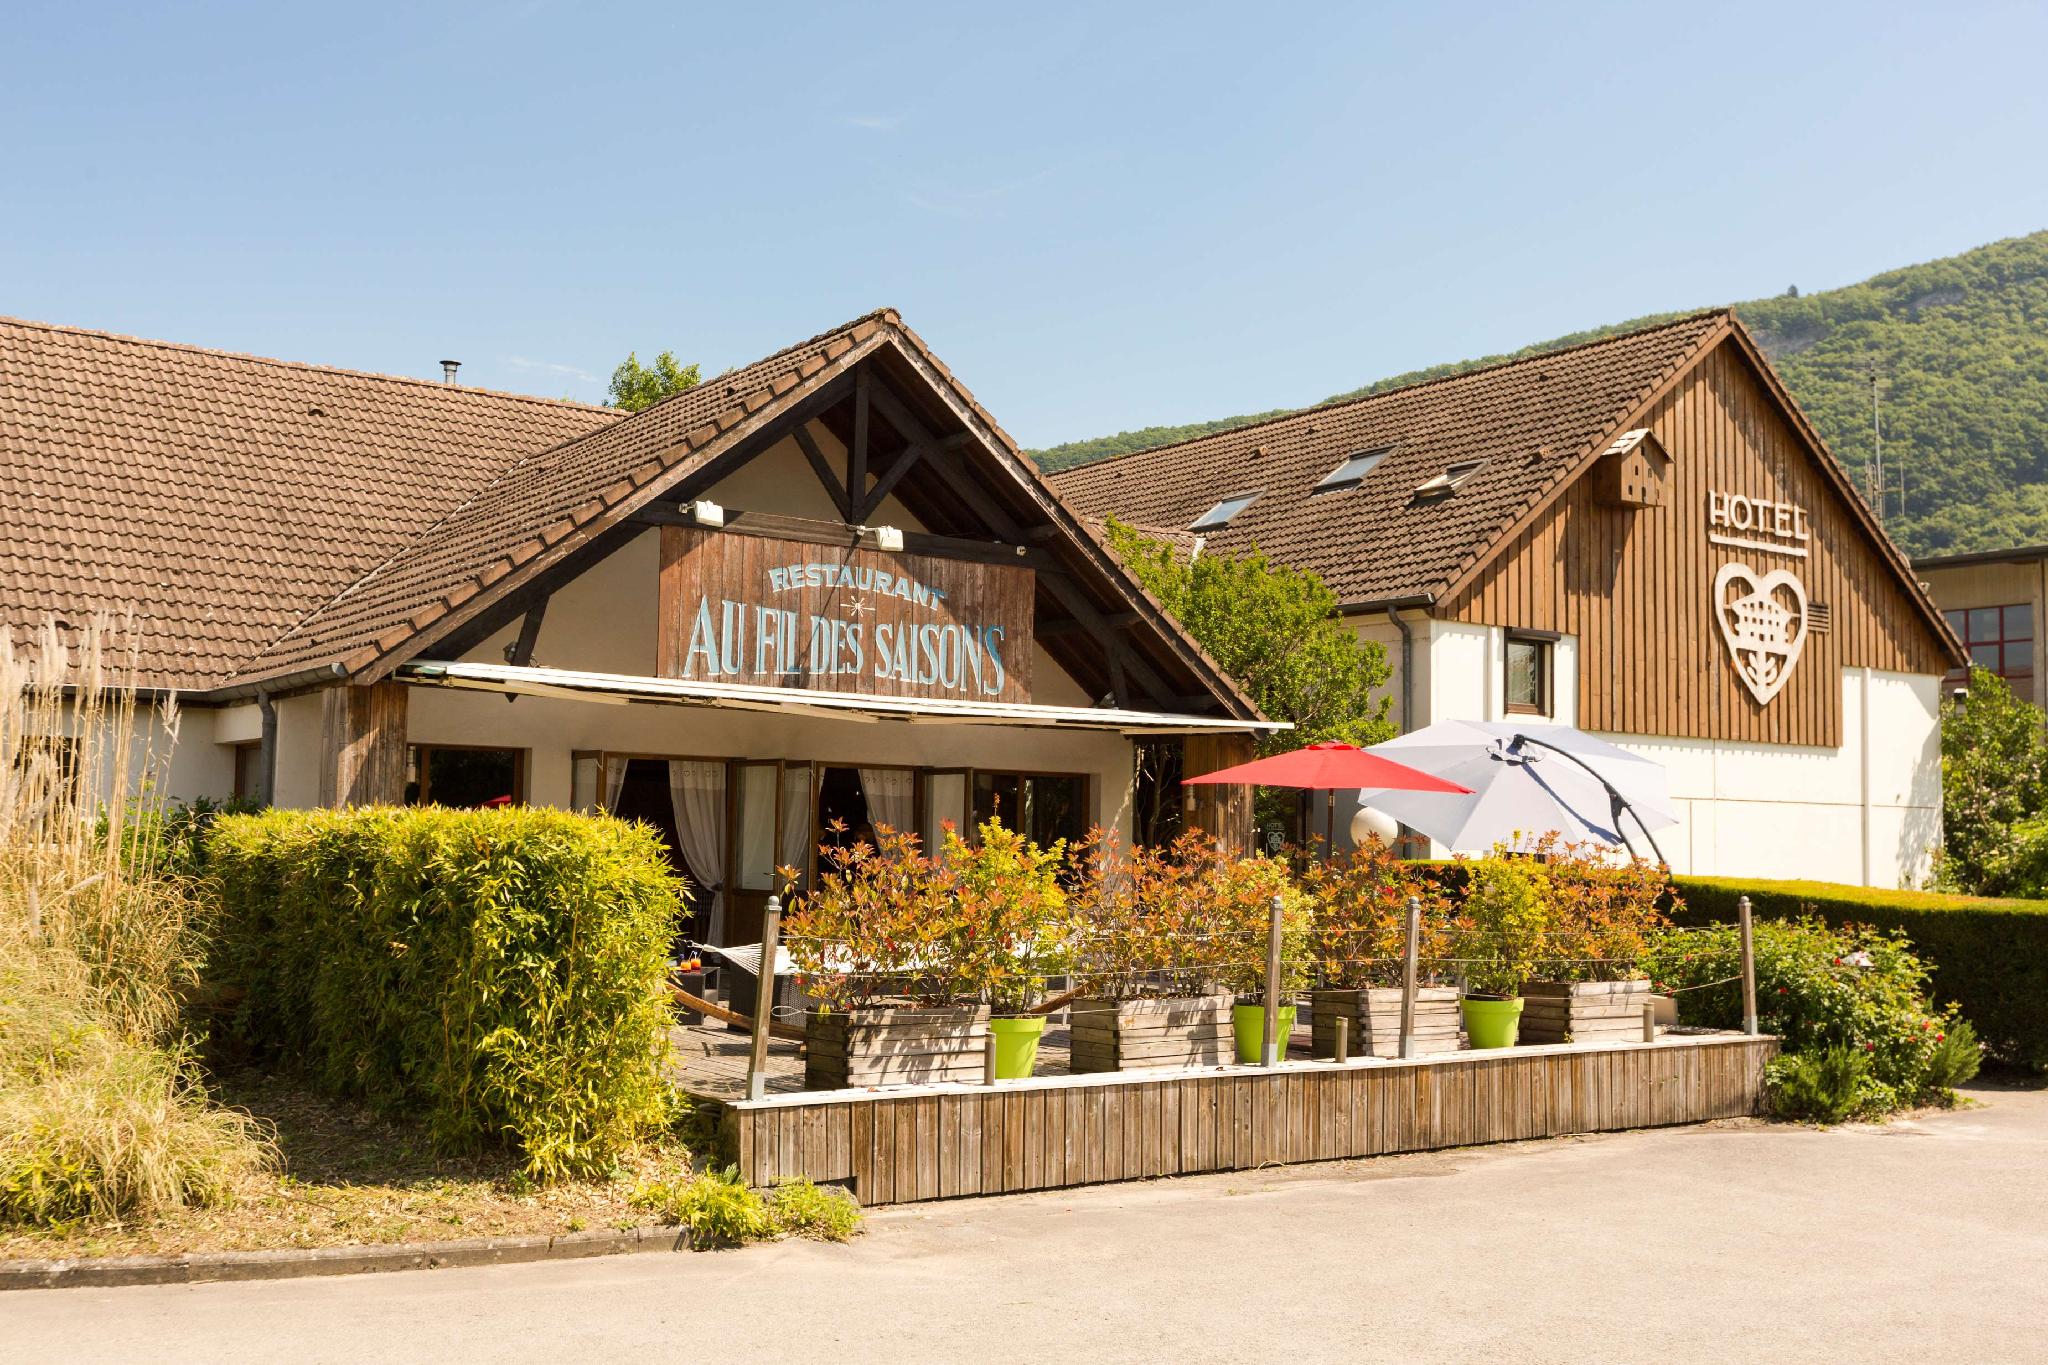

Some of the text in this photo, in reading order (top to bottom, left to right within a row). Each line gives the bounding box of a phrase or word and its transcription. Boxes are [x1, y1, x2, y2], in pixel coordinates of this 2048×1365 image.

[1710, 490, 1809, 540] HOTEL
[769, 562, 947, 611] RESTAURANT
[682, 595, 1006, 695] AU FIL DES SAISONS
